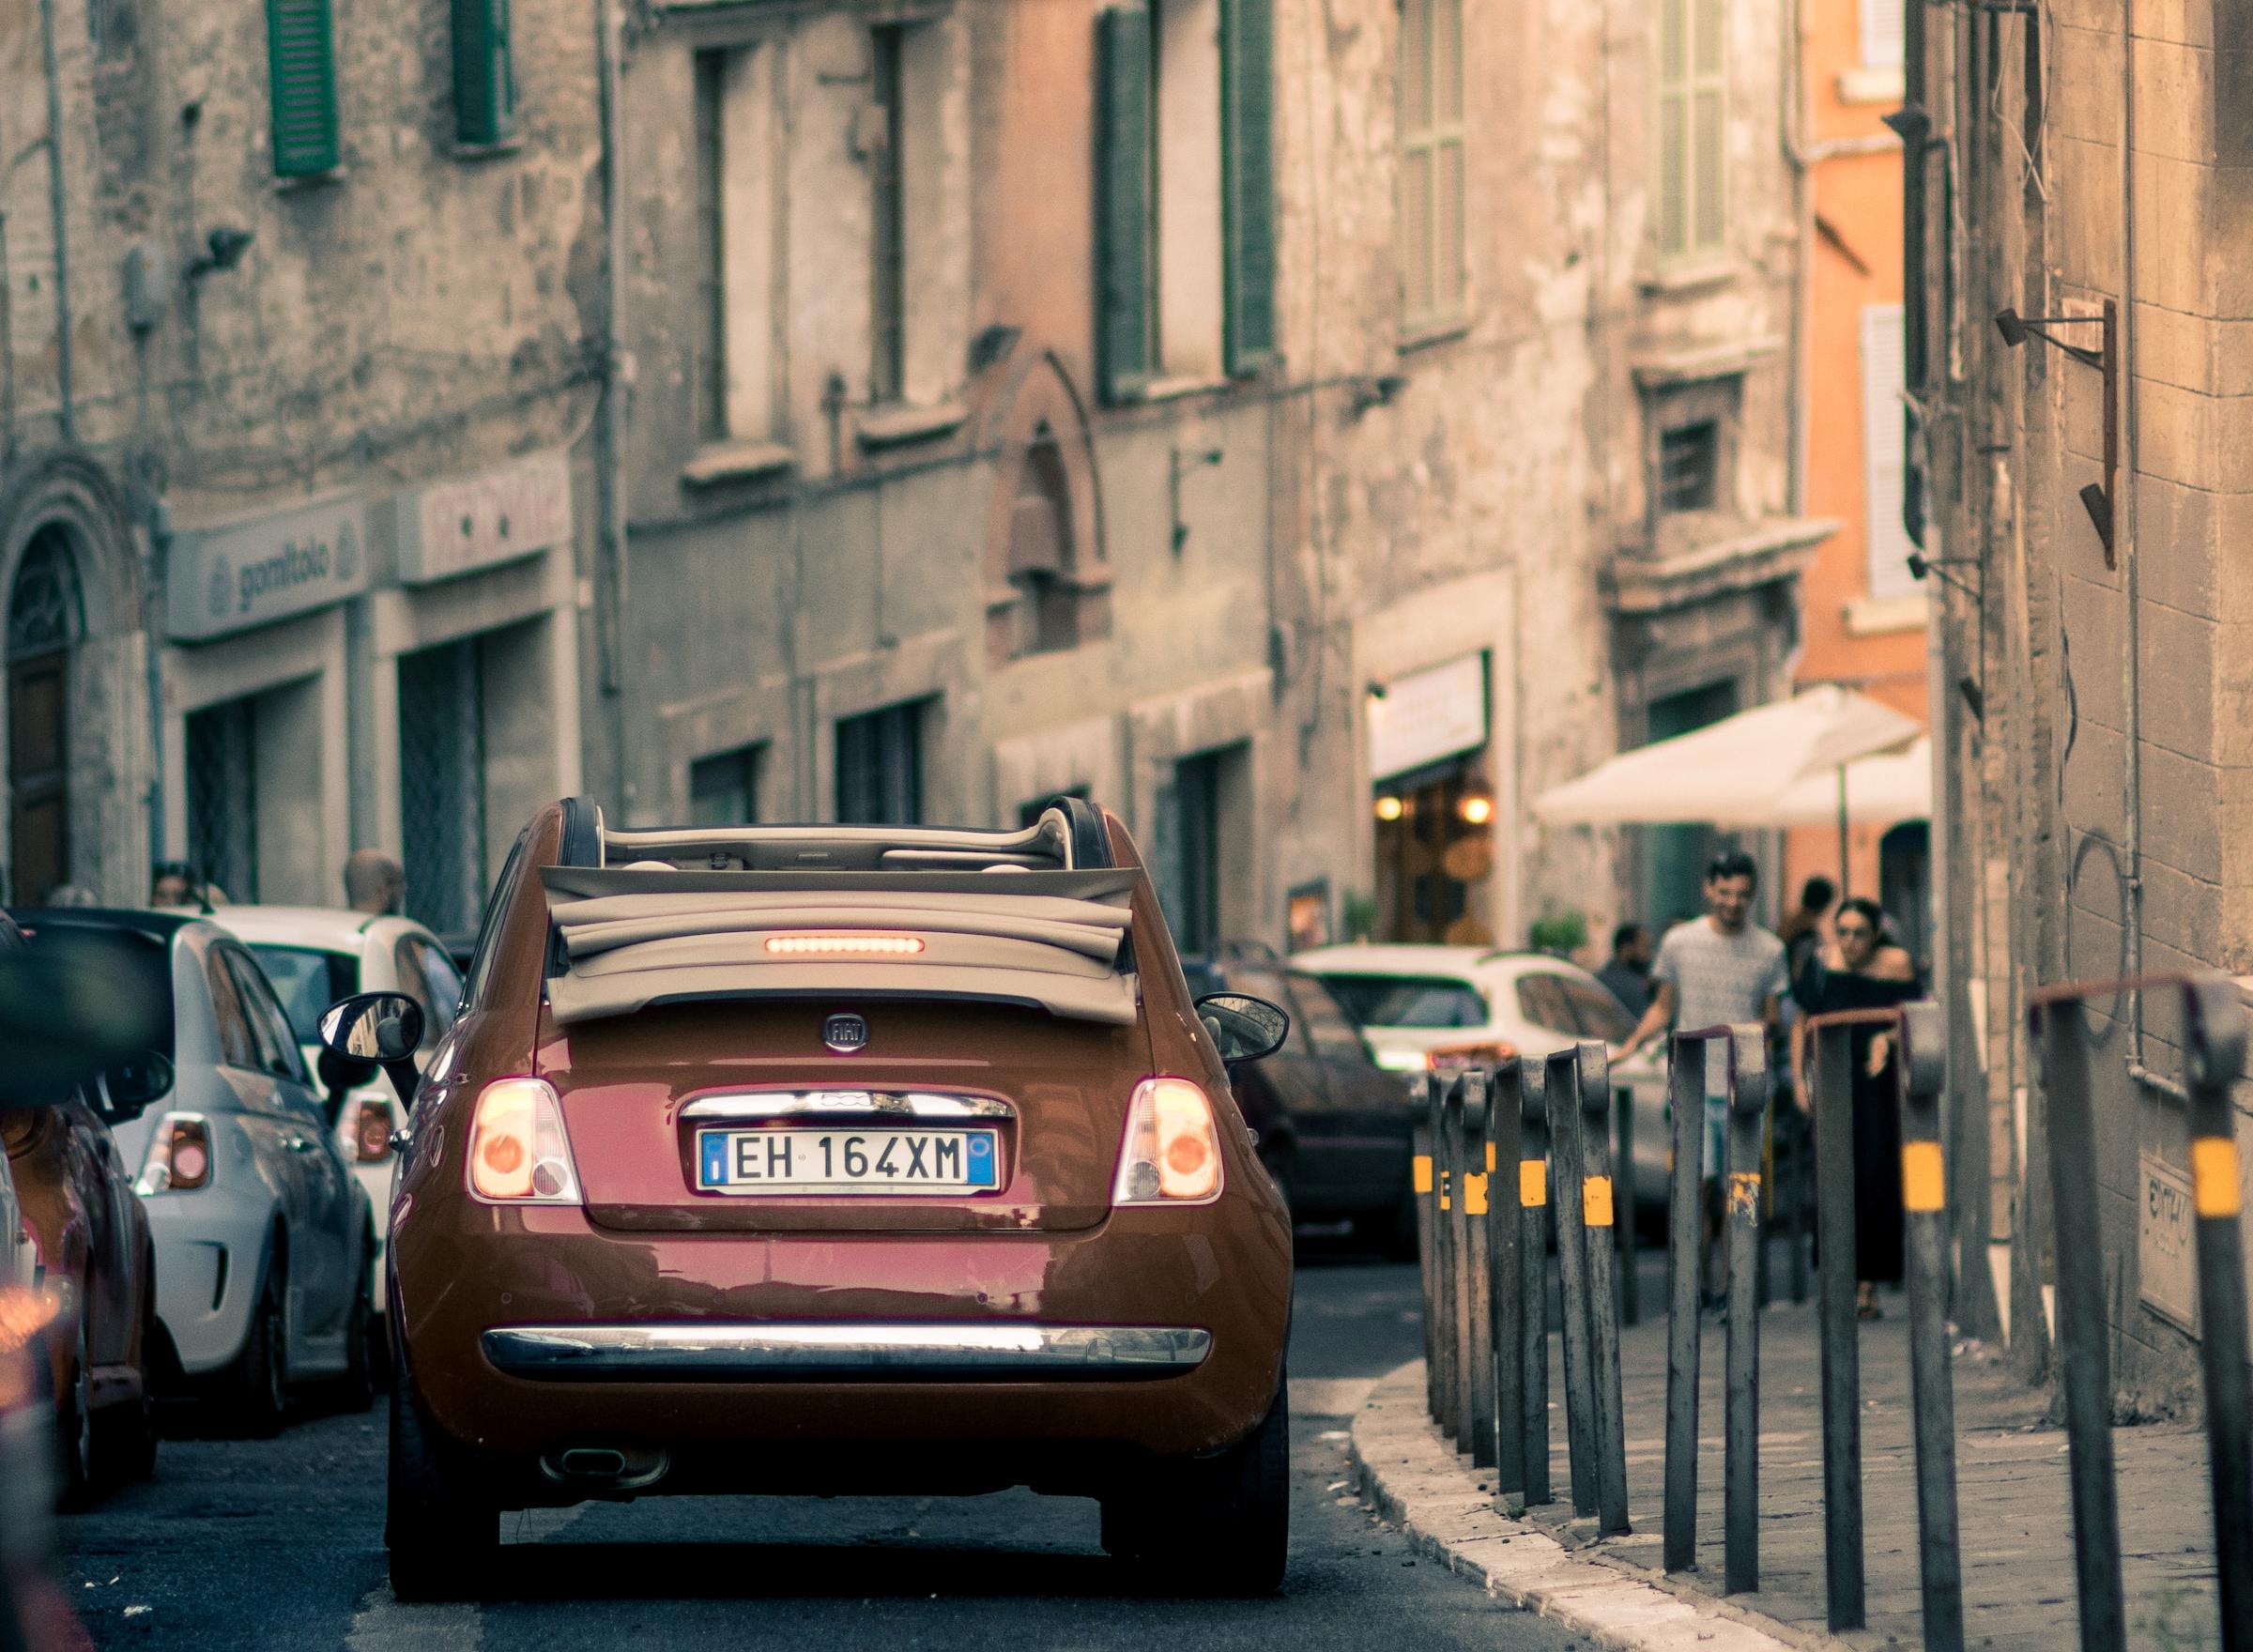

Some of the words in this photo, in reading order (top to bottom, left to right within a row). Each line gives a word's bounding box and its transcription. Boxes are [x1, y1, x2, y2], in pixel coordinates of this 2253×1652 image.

[239, 532, 329, 613] gomitolo
[833, 1023, 861, 1041] FIAT
[712, 1160, 719, 1180] I
[736, 1136, 792, 1179] EH
[819, 1136, 961, 1180] 164XM
